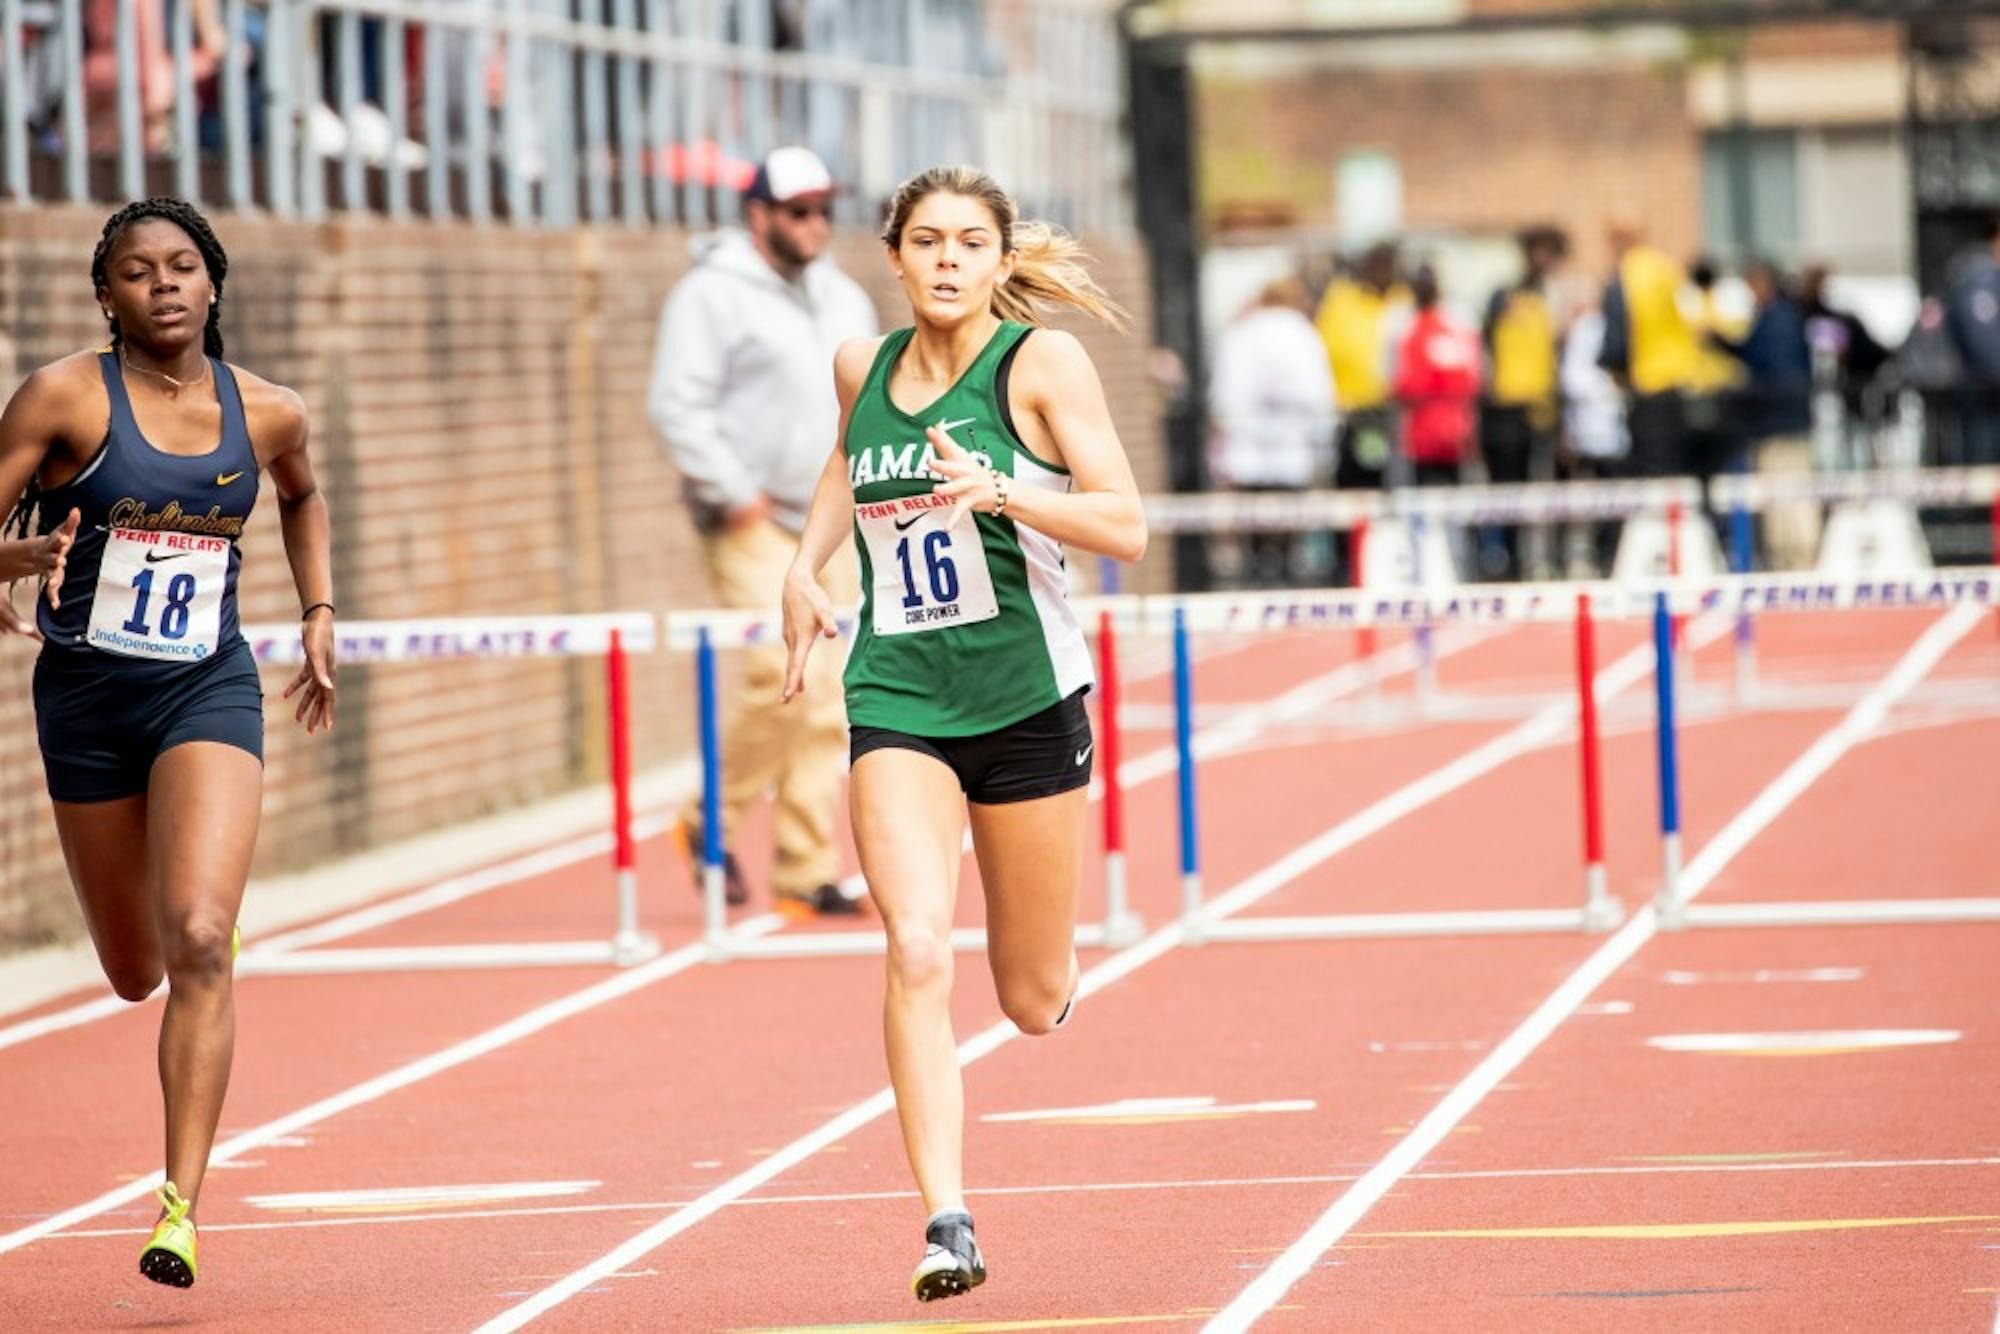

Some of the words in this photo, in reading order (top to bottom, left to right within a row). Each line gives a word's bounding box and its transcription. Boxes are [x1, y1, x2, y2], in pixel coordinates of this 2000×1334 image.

[858, 503, 898, 520] PENN
[114, 528, 161, 545] PENN
[167, 535, 227, 552] RELAYS
[896, 529, 961, 608] 16
[122, 568, 196, 640] 18
[1738, 585, 1838, 611] PENN
[1854, 579, 1990, 607] RELAYS
[905, 610, 925, 624] CORE
[926, 604, 961, 621] POWER
[95, 628, 191, 655] Independence
